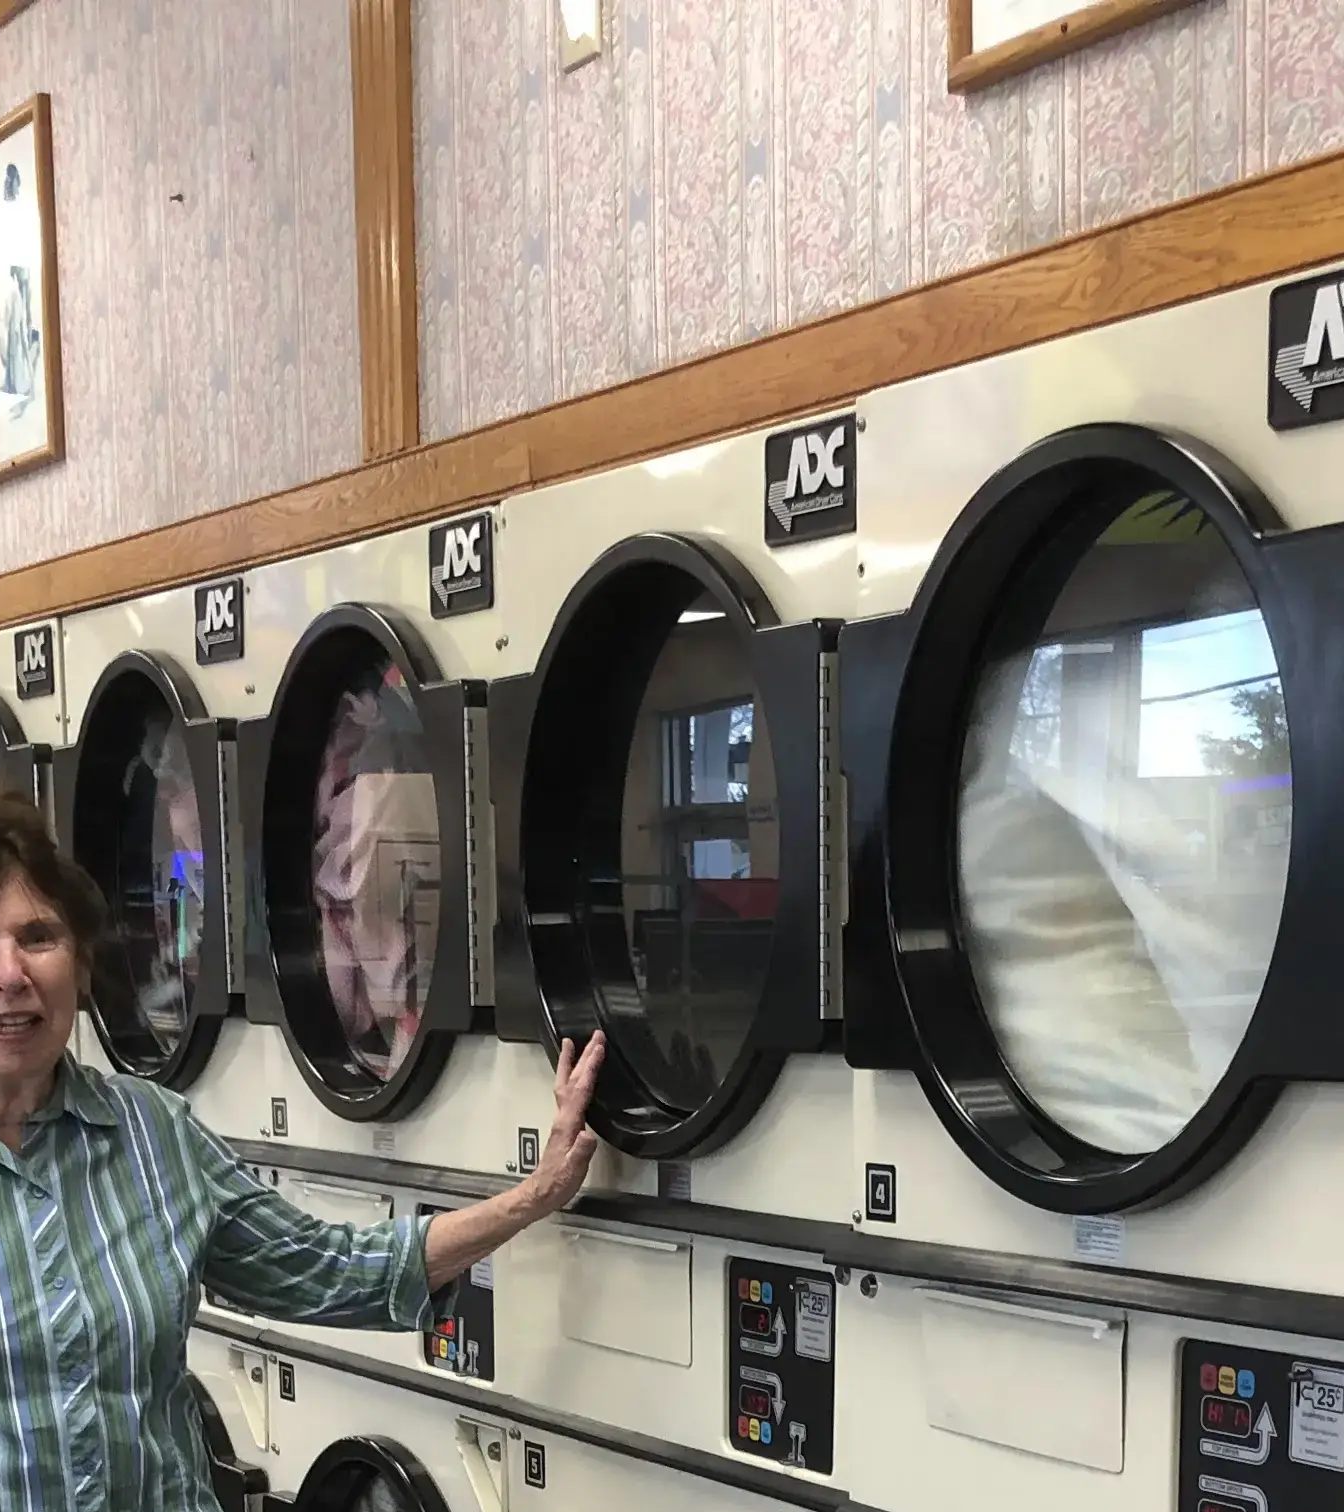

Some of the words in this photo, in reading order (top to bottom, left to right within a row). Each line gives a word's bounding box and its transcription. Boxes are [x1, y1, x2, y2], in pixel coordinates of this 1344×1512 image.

[784, 425, 845, 499] ADC
[441, 522, 481, 580] ADC
[204, 586, 234, 633] ADC
[525, 1141, 533, 1160] 6
[875, 1183, 885, 1204] 4
[531, 1457, 538, 1474] 5
